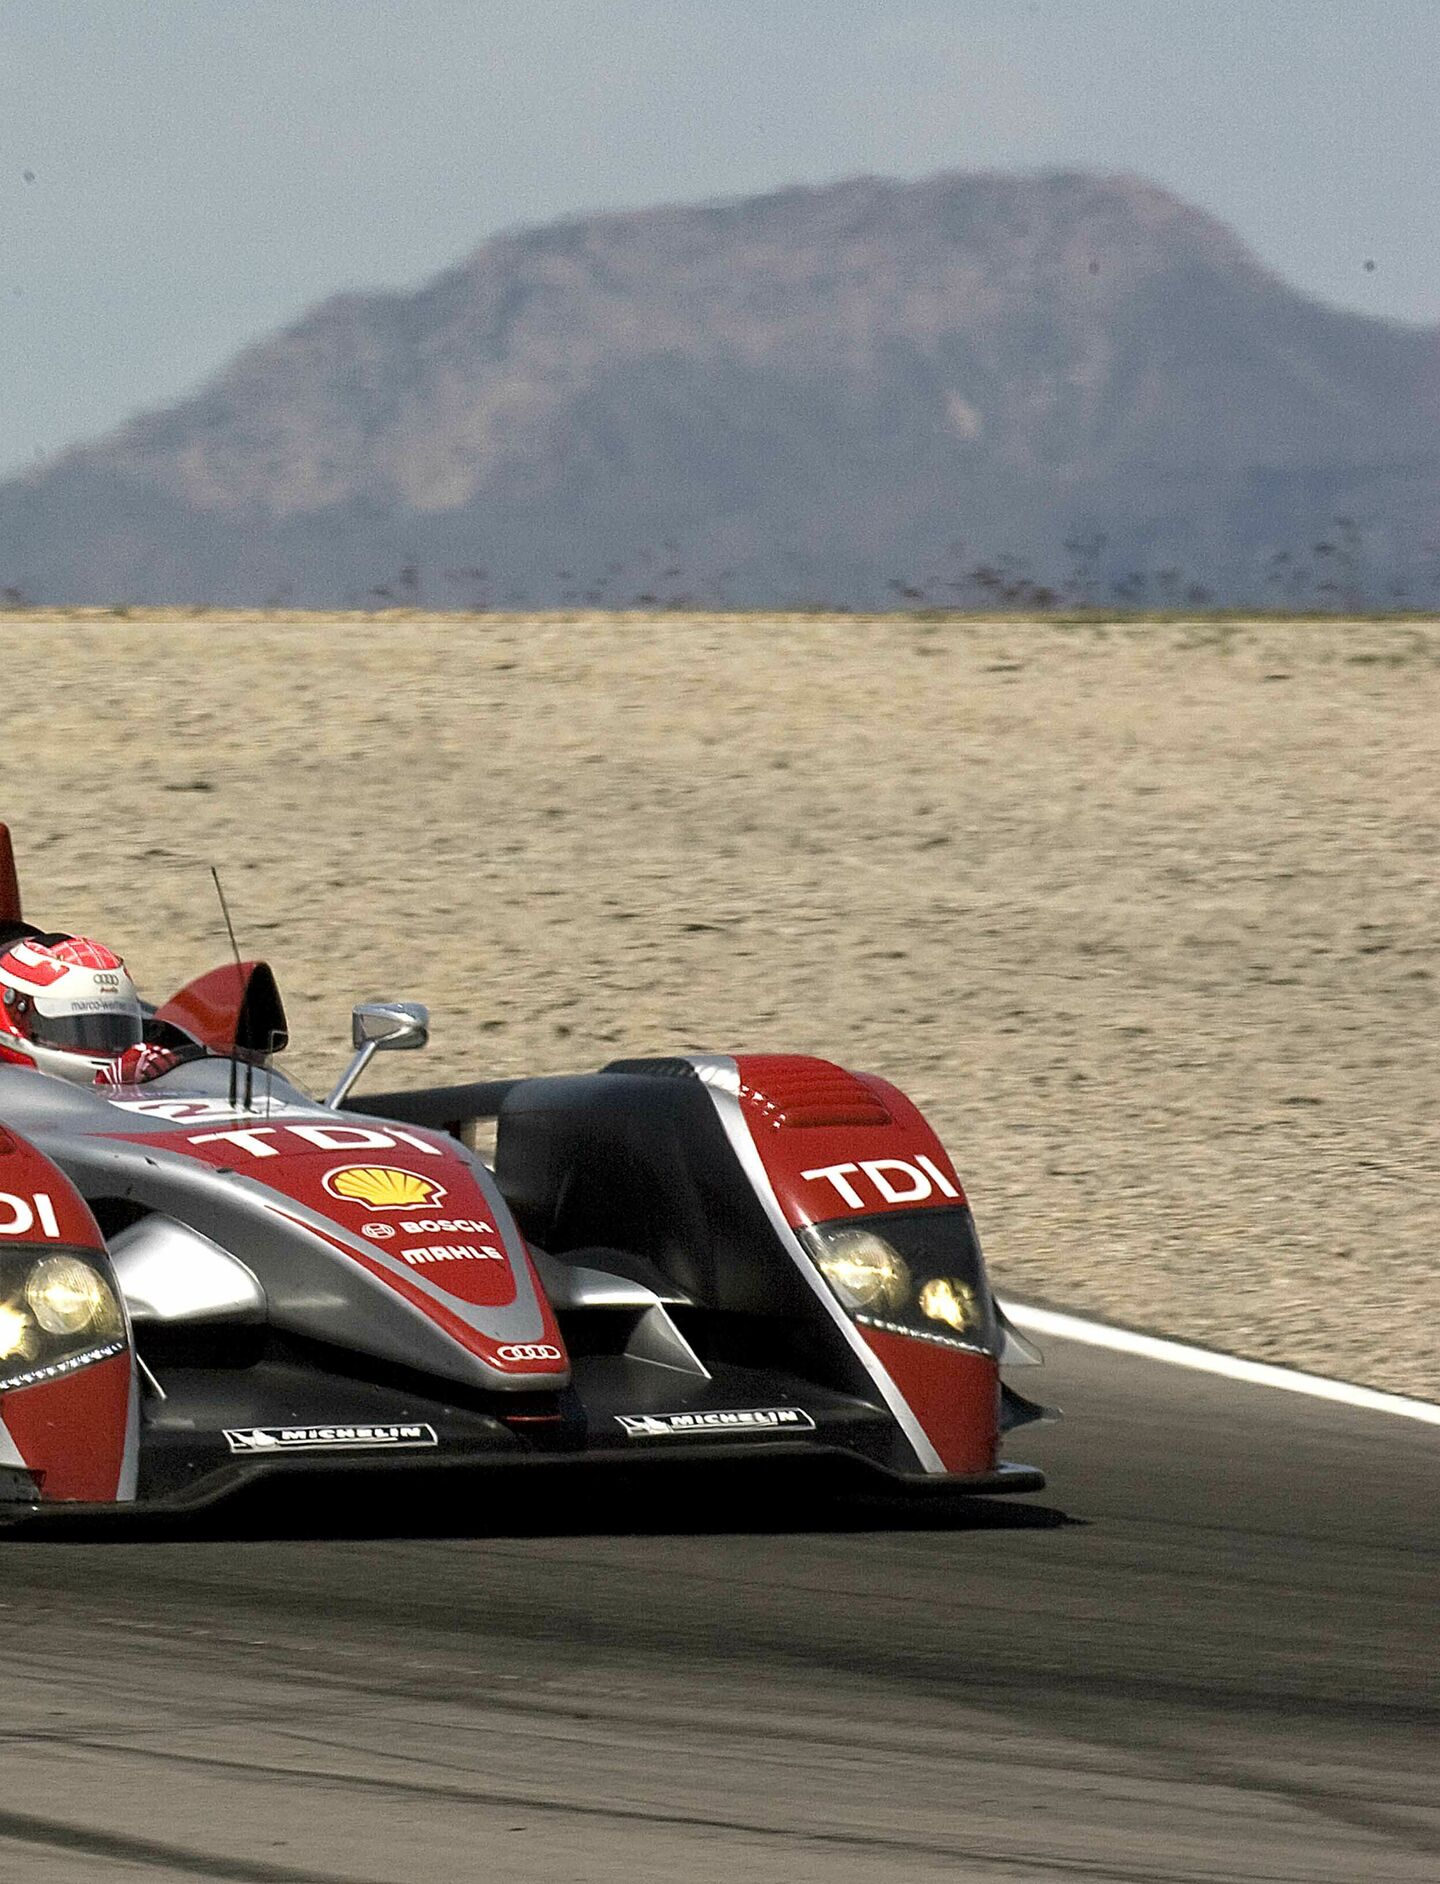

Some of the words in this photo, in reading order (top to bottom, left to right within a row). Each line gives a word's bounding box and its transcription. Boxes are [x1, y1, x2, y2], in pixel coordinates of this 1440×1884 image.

[139, 1104, 209, 1117] 2
[187, 1125, 443, 1157] TDI
[800, 1155, 960, 1210] TDI
[399, 1219, 494, 1234] BOSCH
[401, 1246, 504, 1265] MAHLE
[670, 1411, 798, 1426] MICHELIN
[282, 1427, 420, 1441] MICHELIN
